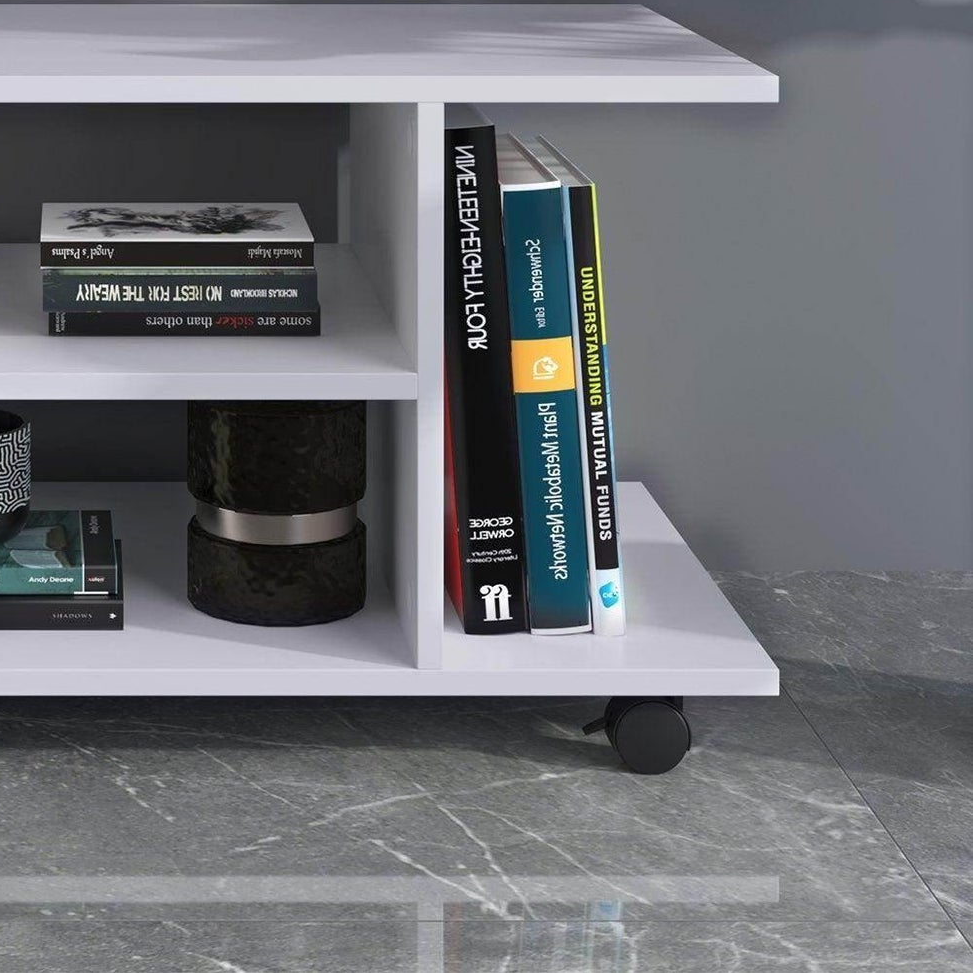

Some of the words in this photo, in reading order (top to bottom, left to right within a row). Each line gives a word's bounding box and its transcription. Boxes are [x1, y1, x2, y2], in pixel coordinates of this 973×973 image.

[52, 248, 80, 259] Psalms
[273, 249, 302, 259] Mostafa
[76, 284, 120, 301] WEARY
[123, 286, 144, 301] THE
[148, 286, 169, 301] FOR
[173, 286, 202, 301] REST
[206, 286, 222, 301] NO
[231, 289, 267, 297] BROOKLAND
[268, 289, 297, 297] NICHOLAS
[146, 316, 183, 328] others
[187, 316, 213, 328] than
[216, 316, 254, 328] sicker
[258, 317, 276, 325] are
[280, 317, 312, 325] some
[581, 266, 604, 406] UNDERSTANDING
[591, 411, 609, 480] MUTUAL
[597, 485, 613, 542] FUNDS
[28, 576, 48, 584] Andy
[52, 612, 93, 620] SHADOWS
